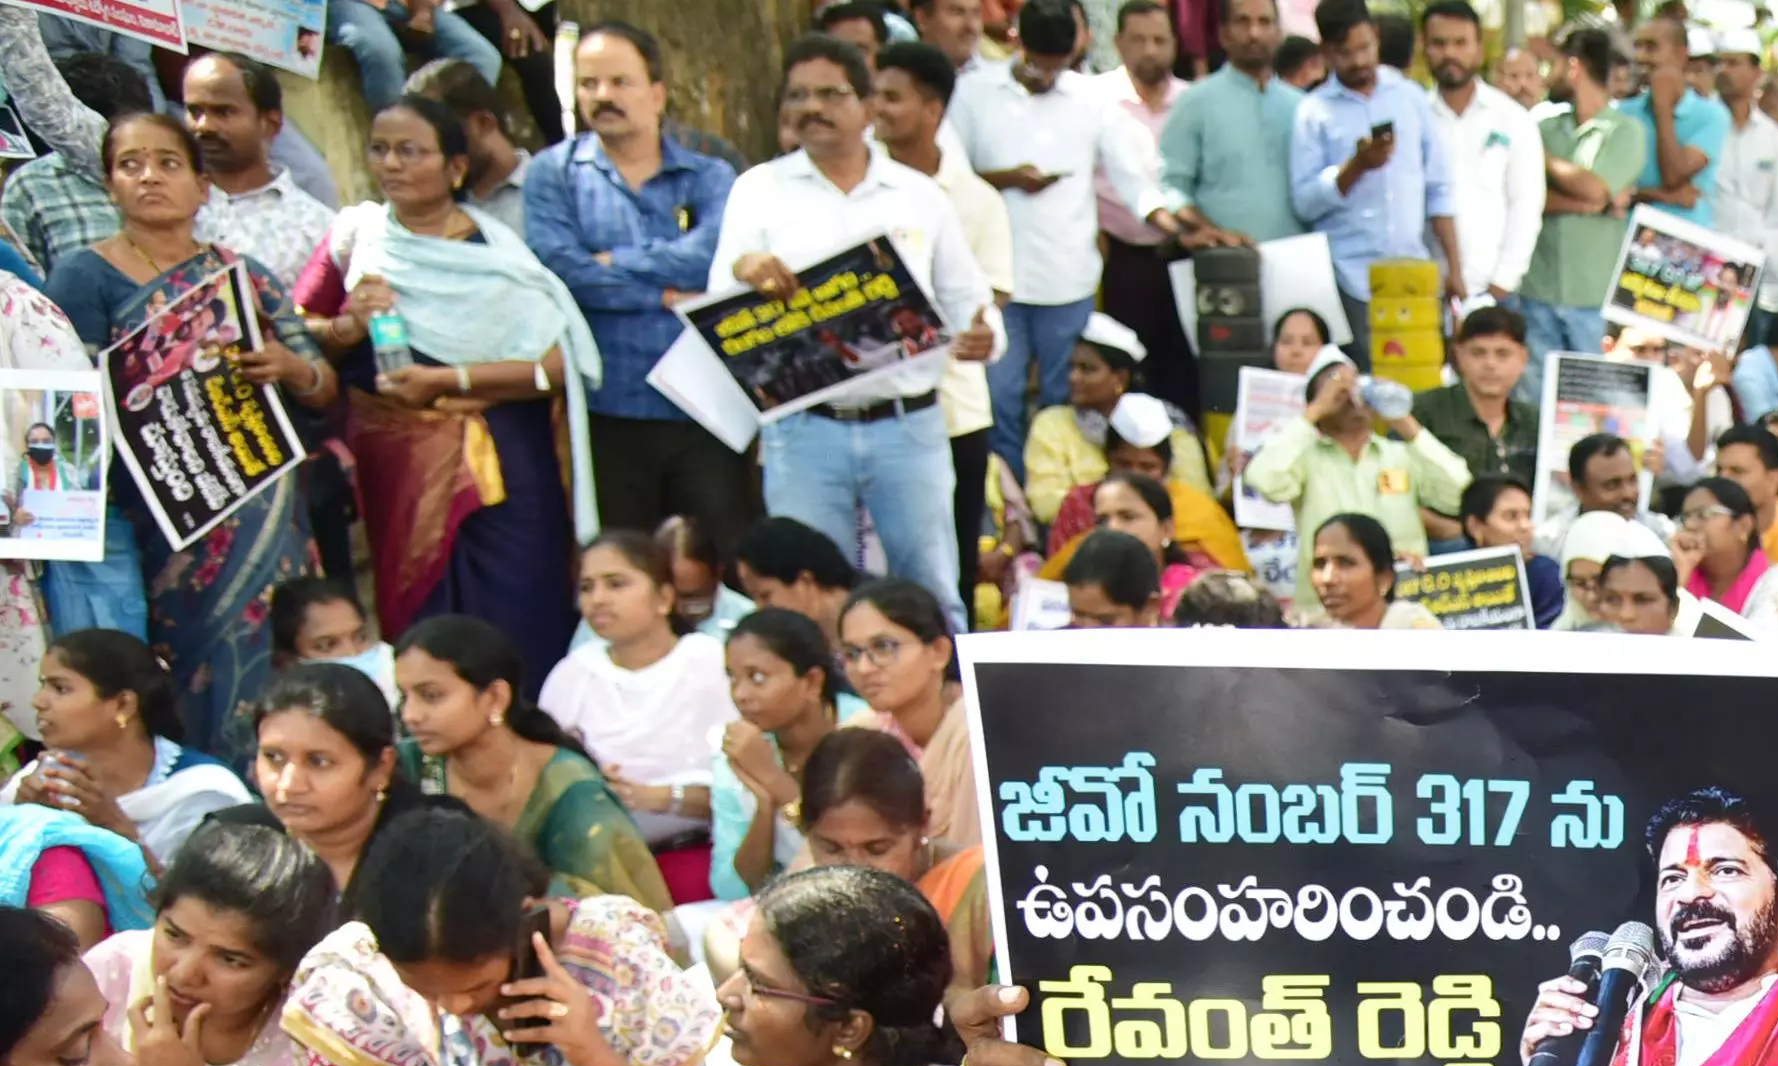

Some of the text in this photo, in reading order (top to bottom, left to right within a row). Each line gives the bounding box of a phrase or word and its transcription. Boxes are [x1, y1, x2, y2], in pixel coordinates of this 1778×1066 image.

[999, 751, 1625, 849] జీవో నంబర్ 317 ను
[1039, 964, 1333, 1060] రేవంత్
